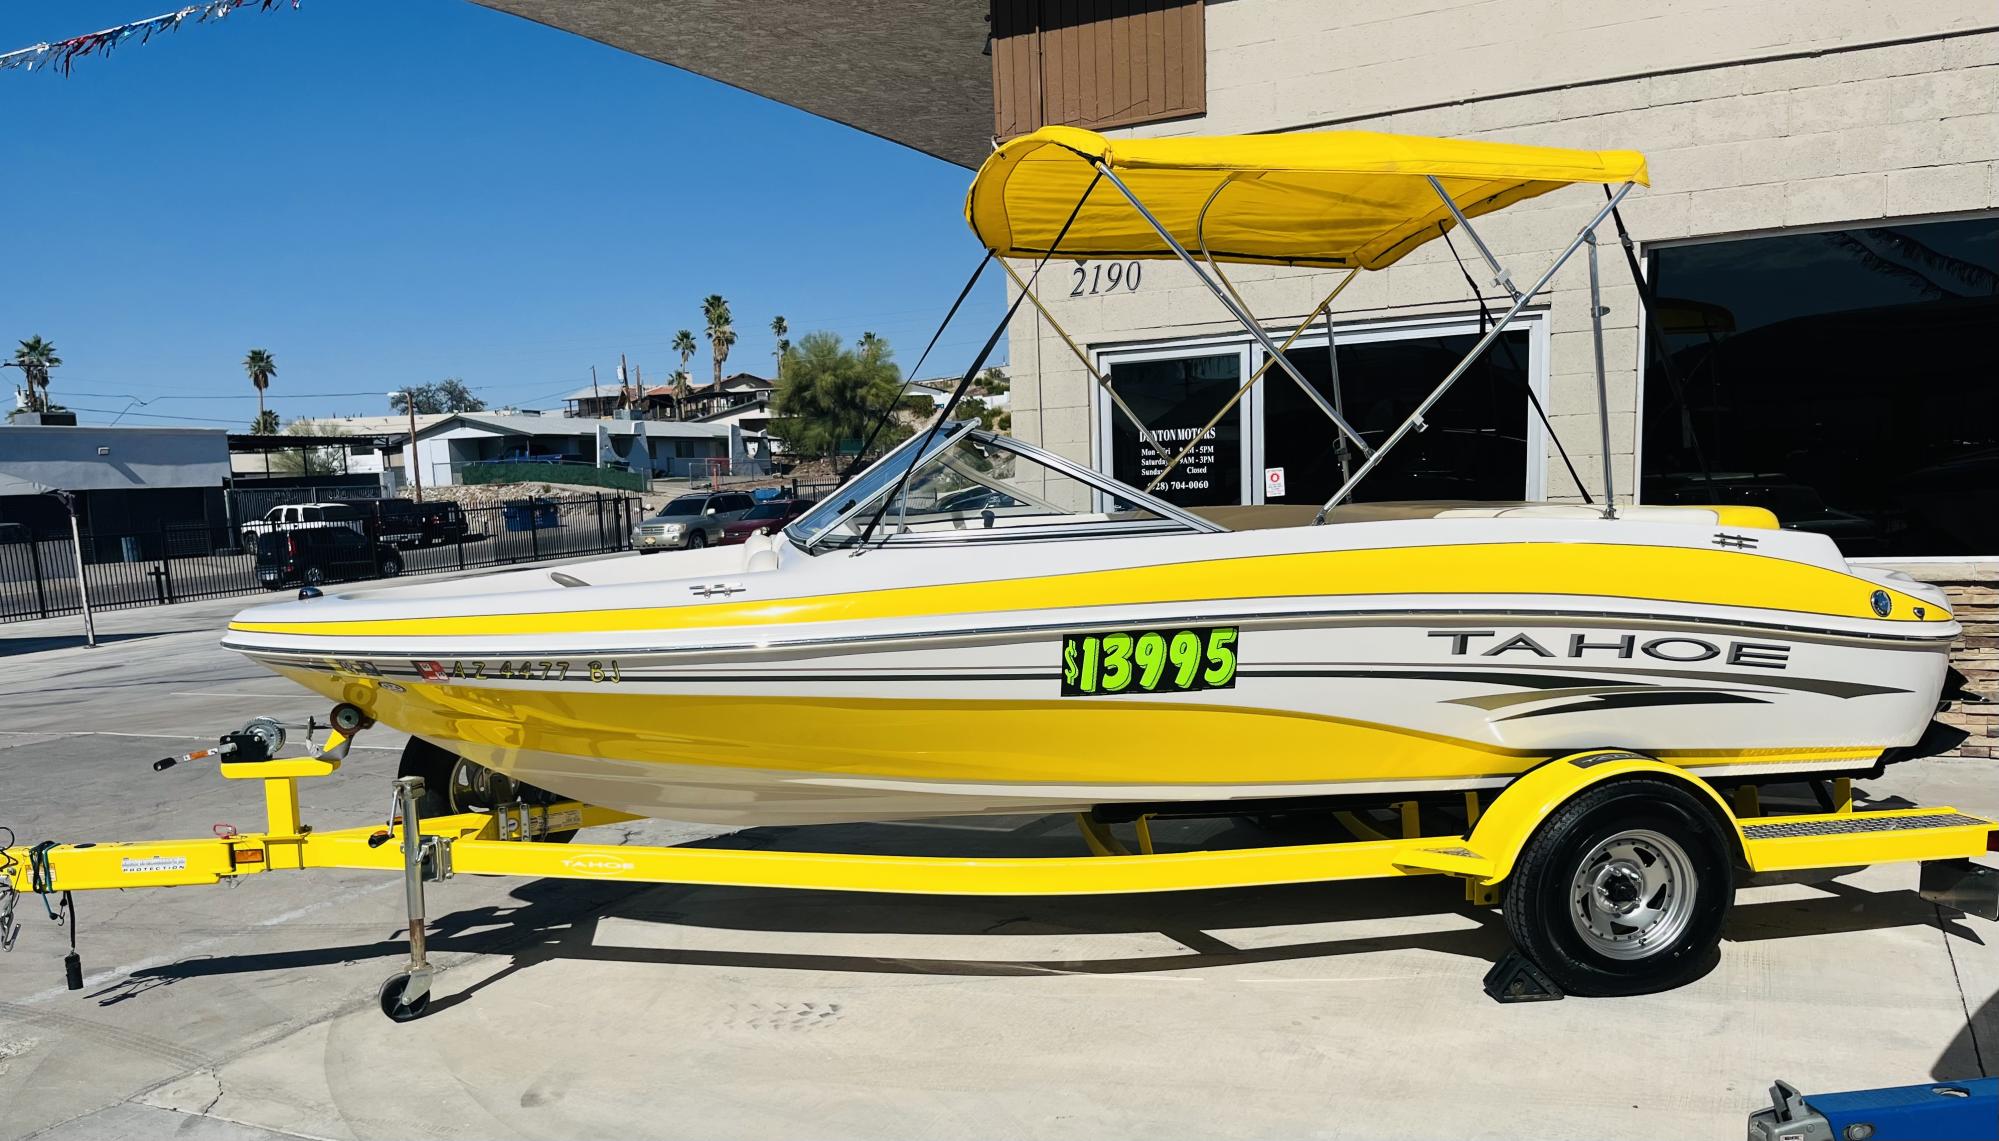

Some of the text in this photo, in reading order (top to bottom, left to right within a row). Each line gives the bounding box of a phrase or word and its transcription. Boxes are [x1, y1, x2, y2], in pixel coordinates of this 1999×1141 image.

[1070, 261, 1141, 297] 2190
[1140, 429, 1176, 442] DNTON
[1161, 447, 1171, 455] ri
[1199, 446, 1214, 454] 5PM
[1199, 456, 1214, 464] 3PM
[1141, 466, 1207, 477] Sunda Closed
[1170, 480, 1209, 490] 704-0060
[1427, 630, 1791, 669] TAHOE
[1064, 627, 1238, 693] $13995
[453, 660, 488, 680] AZ
[500, 660, 570, 681] 4477
[587, 660, 621, 684] BJ
[561, 859, 635, 870] TAHOE
